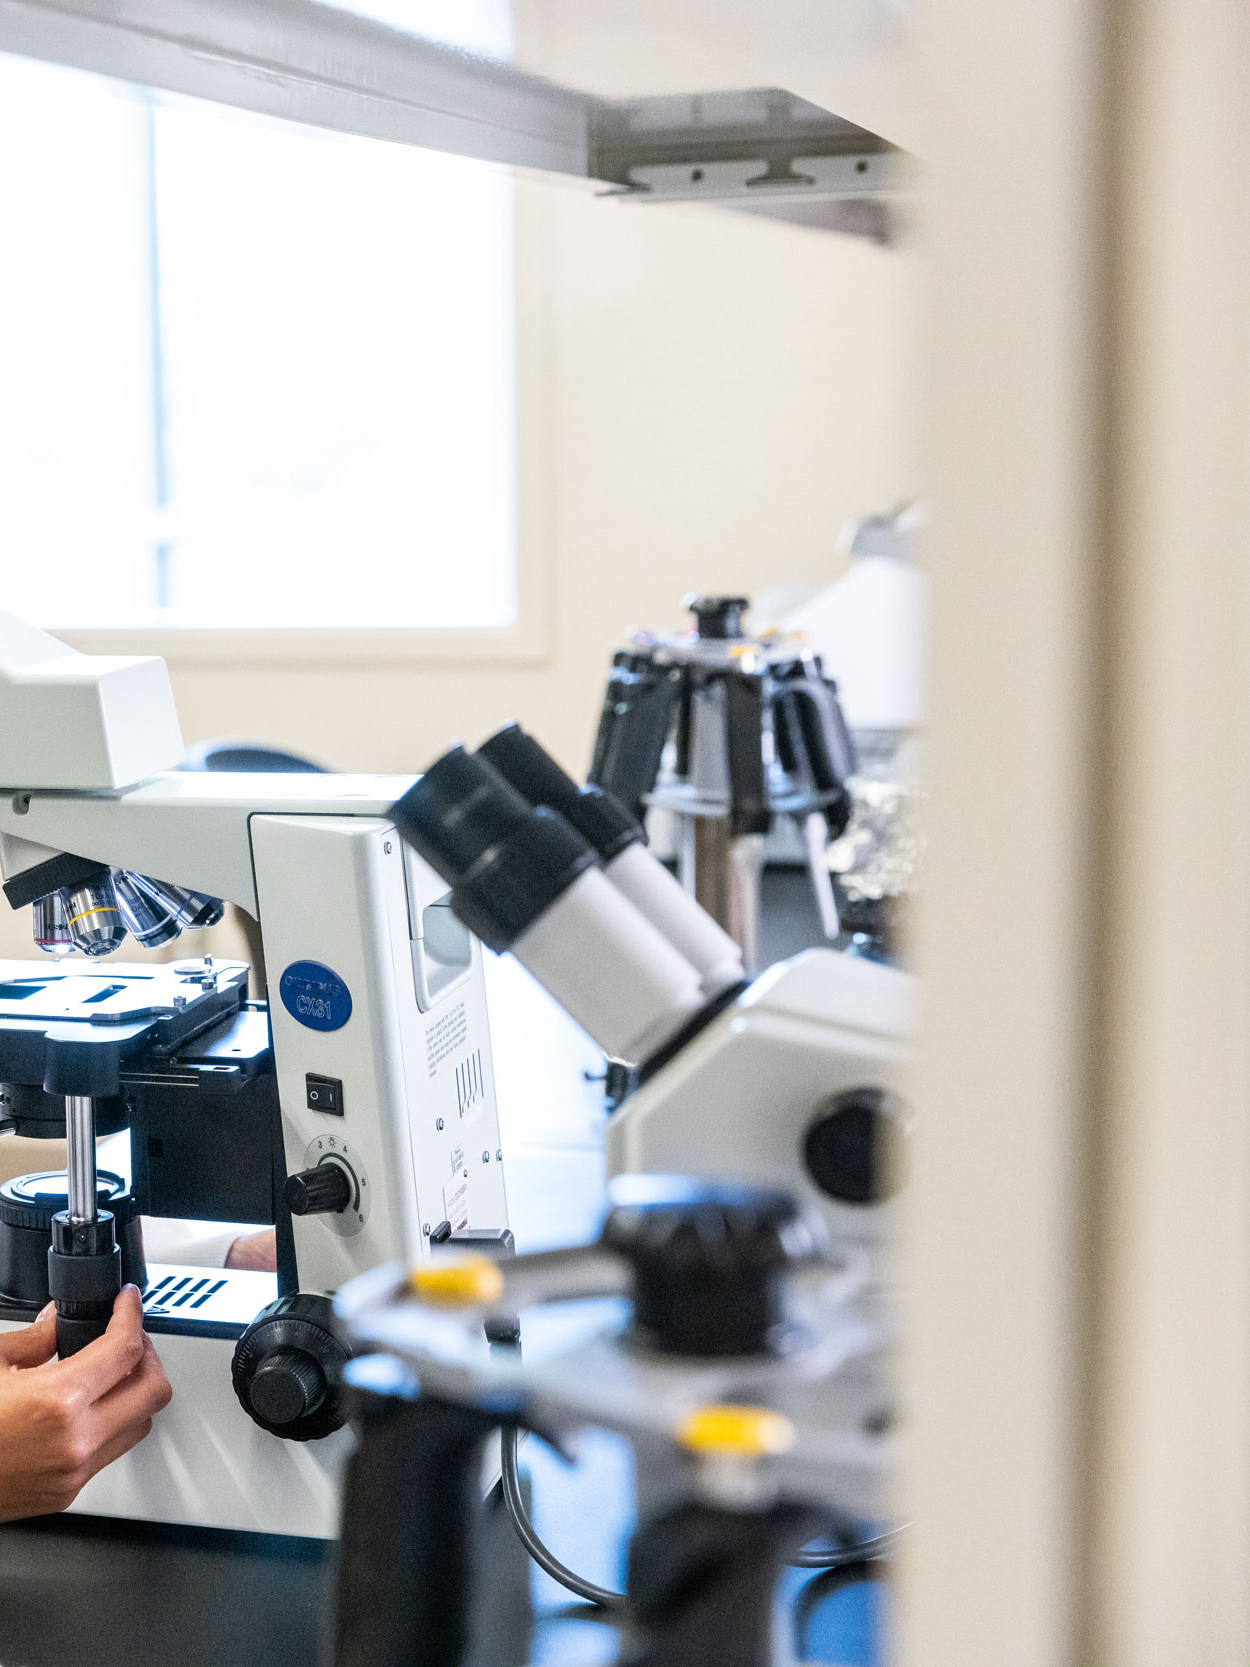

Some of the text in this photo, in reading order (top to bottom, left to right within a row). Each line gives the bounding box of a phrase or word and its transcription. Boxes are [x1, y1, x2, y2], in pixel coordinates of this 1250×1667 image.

[296, 995, 332, 1020] CX31
[317, 1141, 323, 1149] 3
[361, 1178, 367, 1187] 5
[358, 1214, 364, 1222] 6
